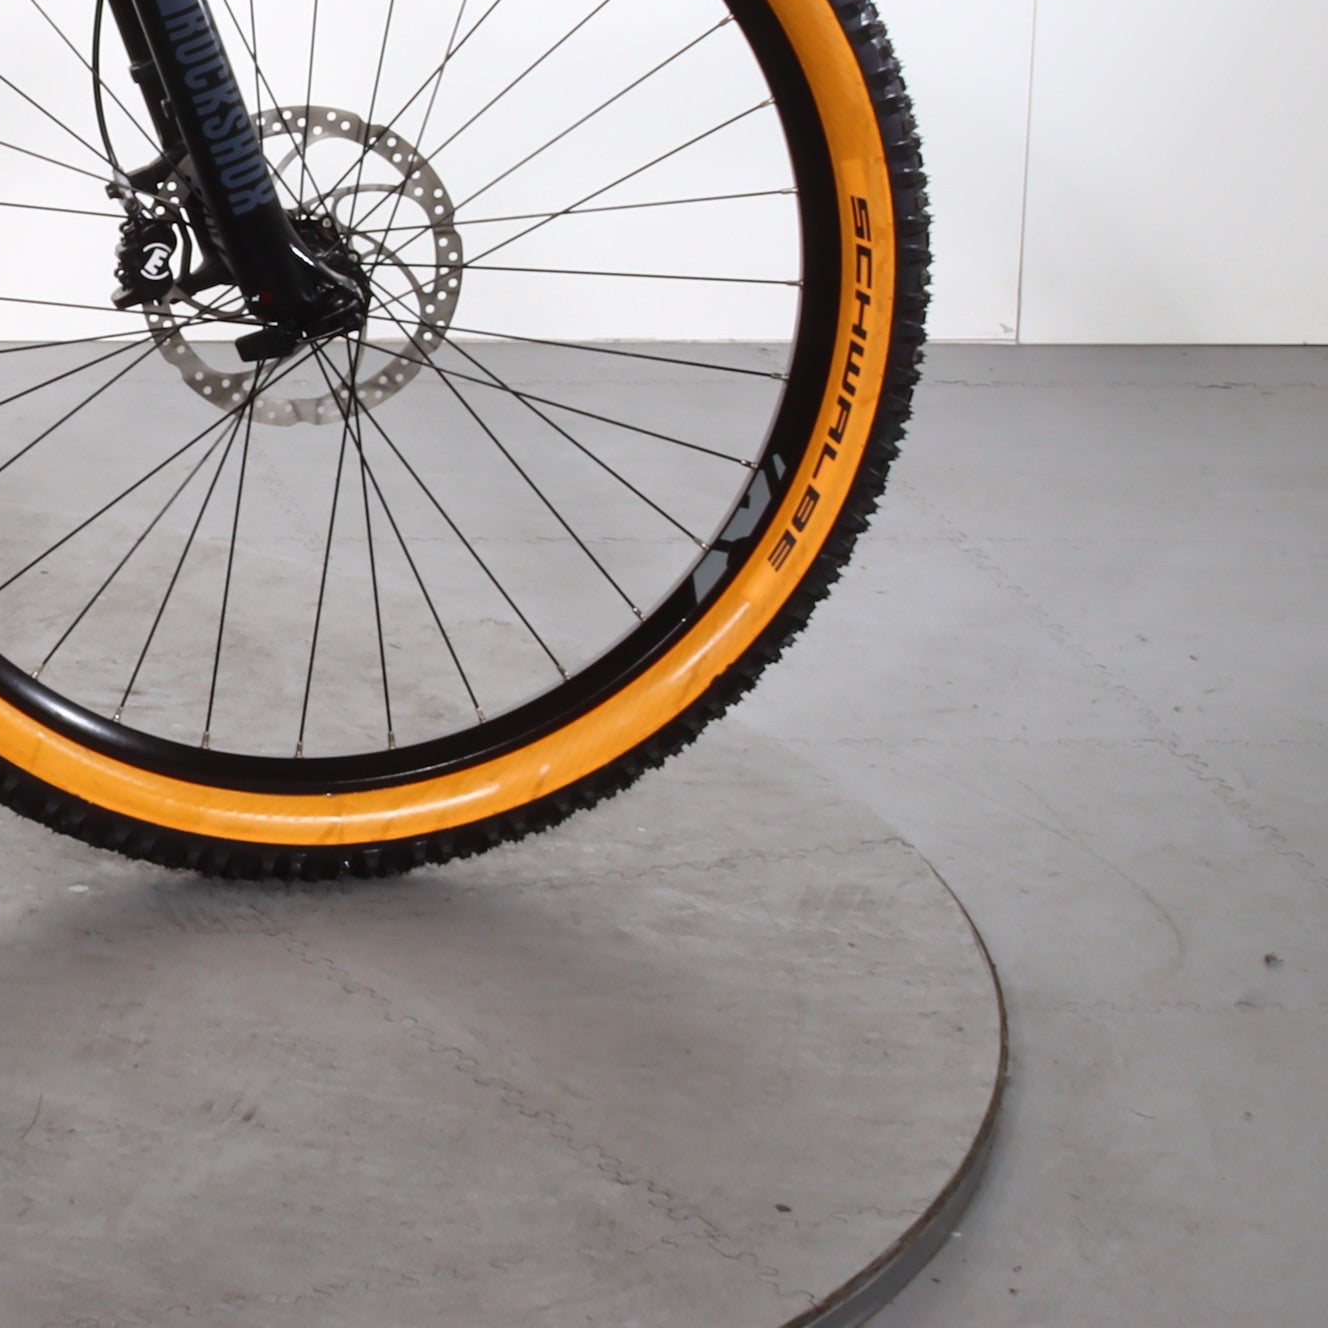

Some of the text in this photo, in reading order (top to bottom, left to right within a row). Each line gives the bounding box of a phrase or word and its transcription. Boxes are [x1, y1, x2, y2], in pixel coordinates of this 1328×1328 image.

[165, 2, 275, 217] ROCKSHOX
[144, 247, 169, 276] E
[768, 196, 873, 573] SCHWALBE
